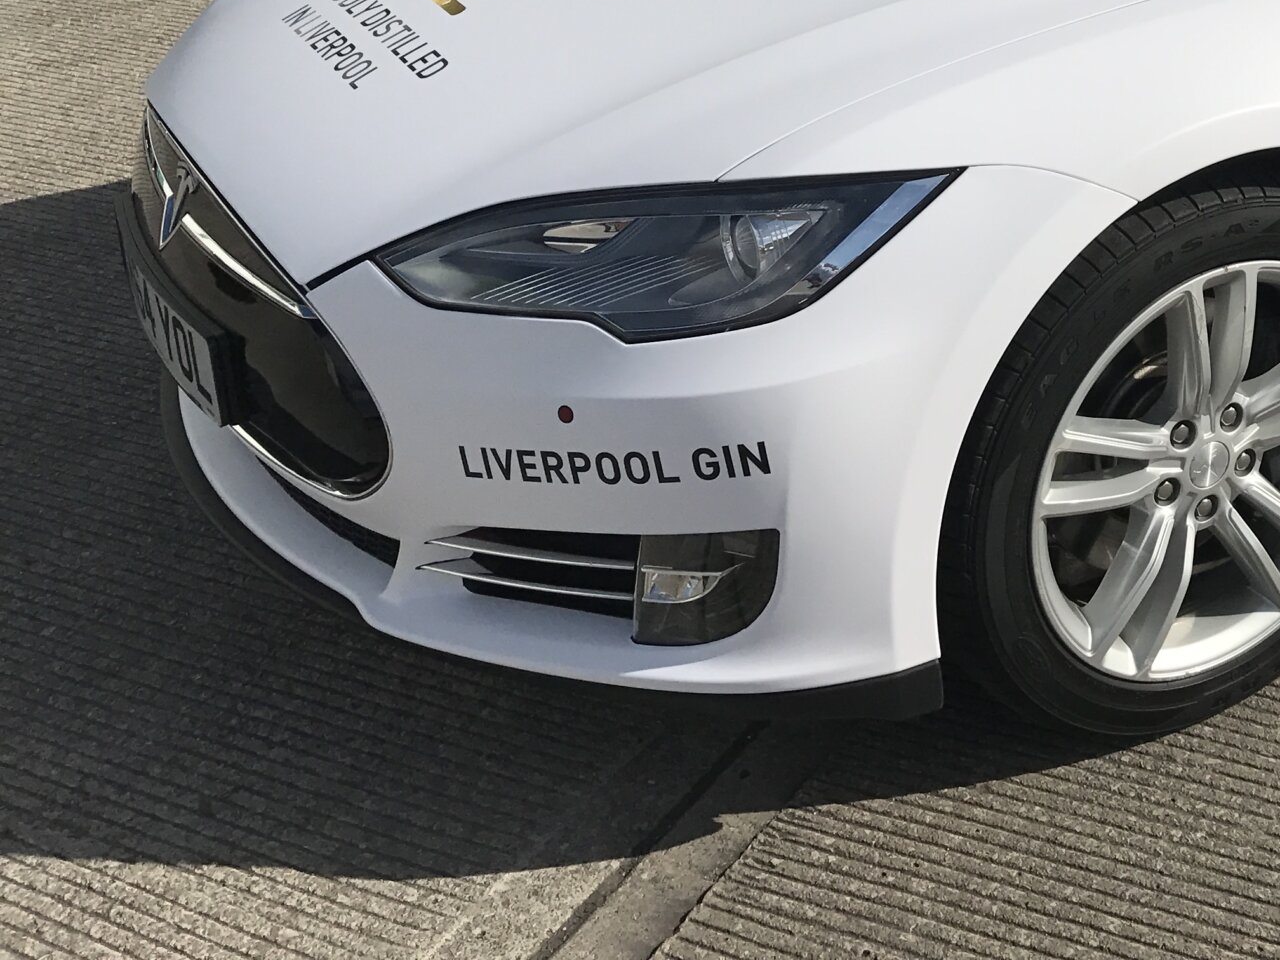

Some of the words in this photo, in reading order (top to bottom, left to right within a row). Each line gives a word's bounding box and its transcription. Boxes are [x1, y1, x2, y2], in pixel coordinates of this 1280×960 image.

[281, 4, 312, 27] IN
[360, 7, 449, 80] DISTILLED
[294, 10, 378, 90] LIVERPOOL
[458, 445, 681, 485] LIVERPOOL
[691, 440, 772, 482] GIN
